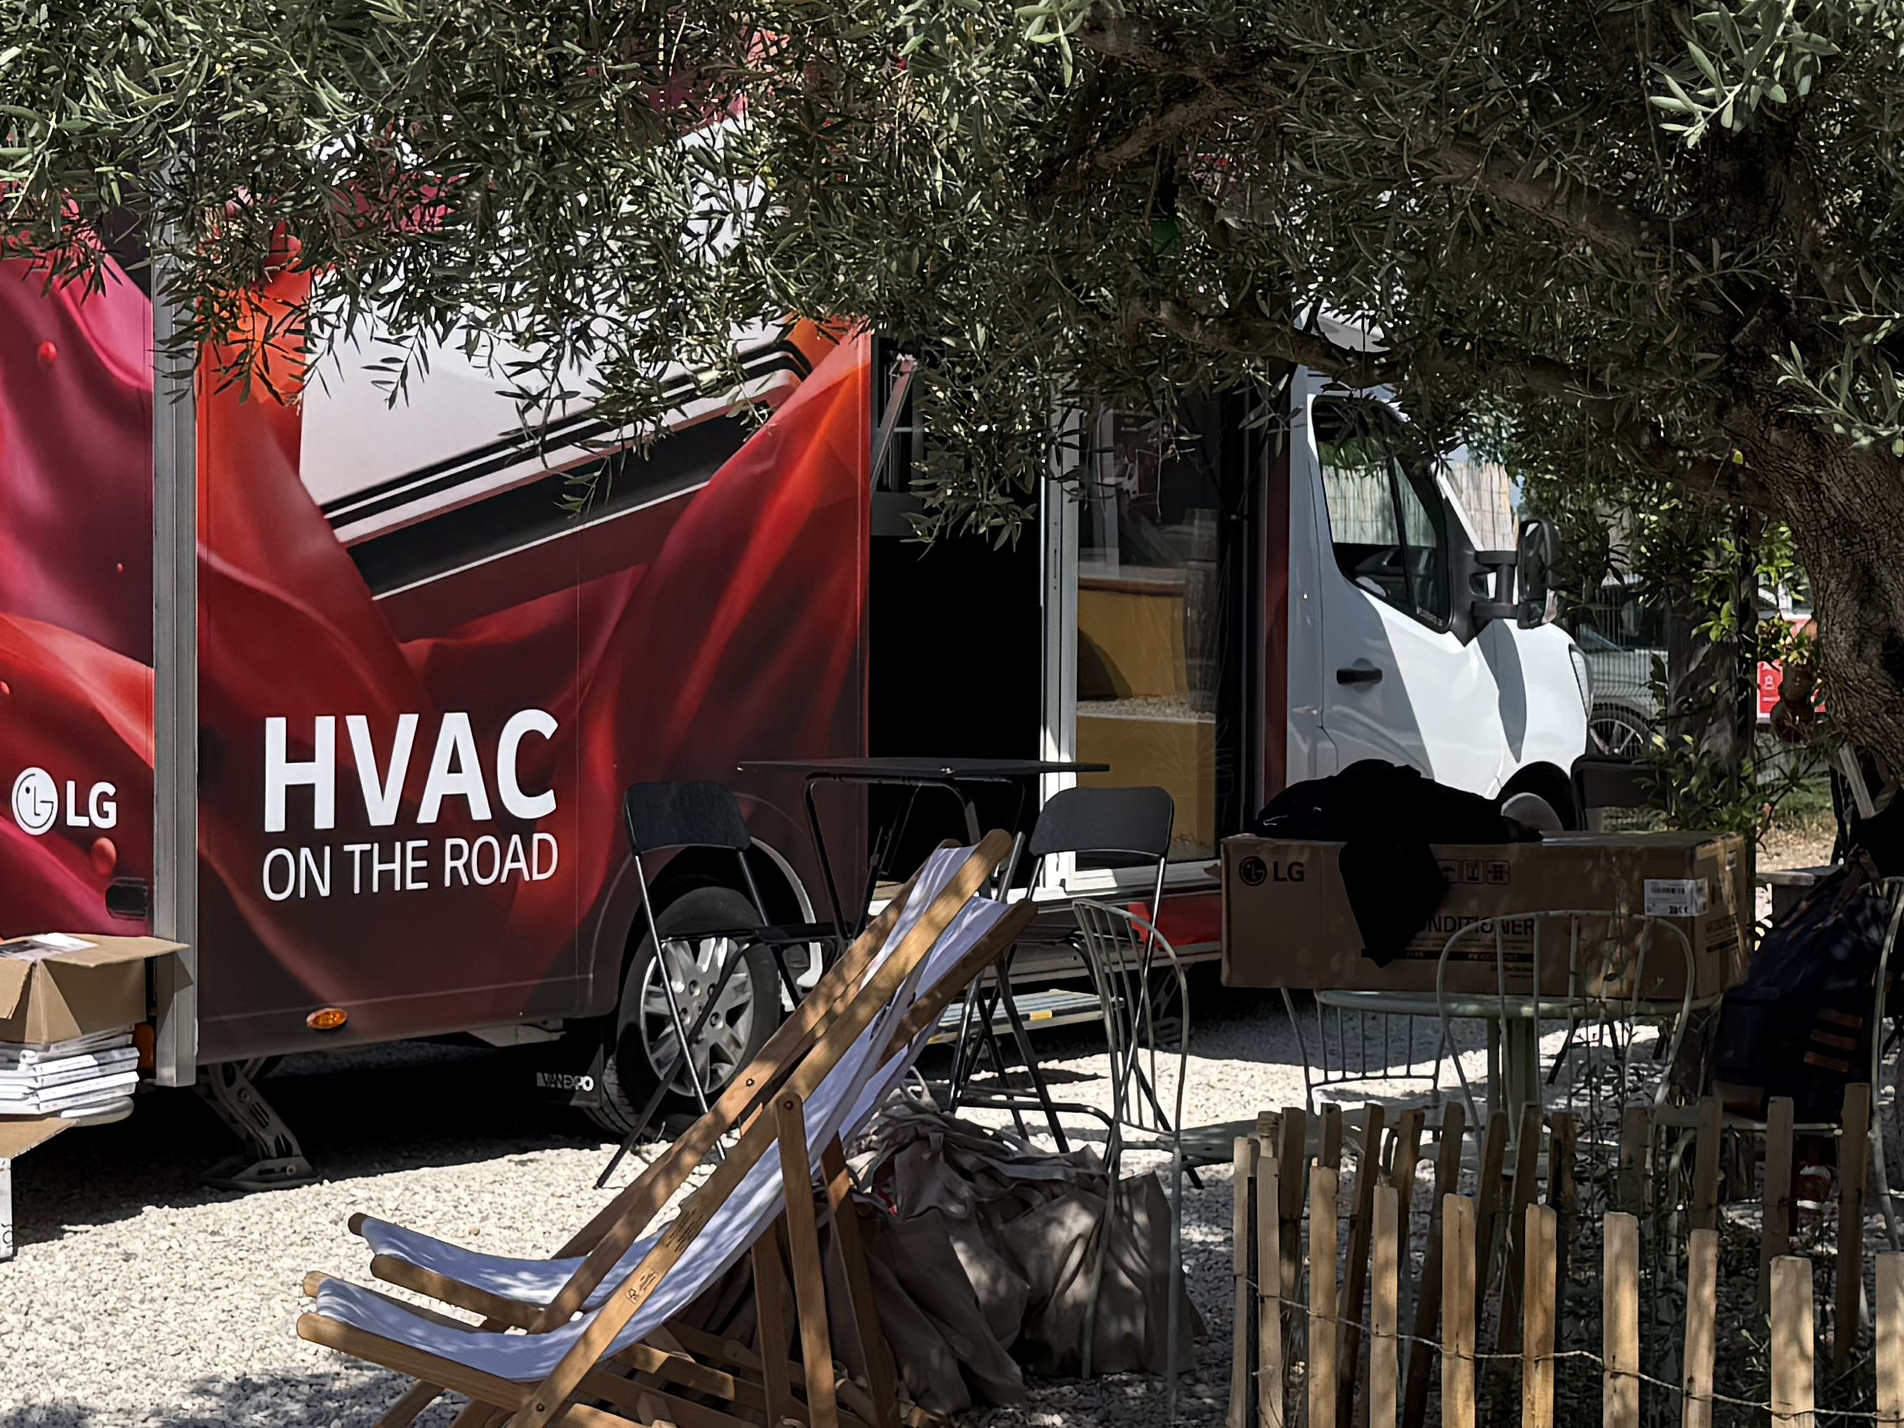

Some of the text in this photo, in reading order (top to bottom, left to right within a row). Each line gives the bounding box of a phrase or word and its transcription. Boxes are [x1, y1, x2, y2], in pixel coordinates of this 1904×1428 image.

[264, 708, 559, 833] HVAC
[65, 779, 118, 830] LG
[262, 831, 559, 902] ON THE ROAD
[1272, 860, 1305, 883] LG
